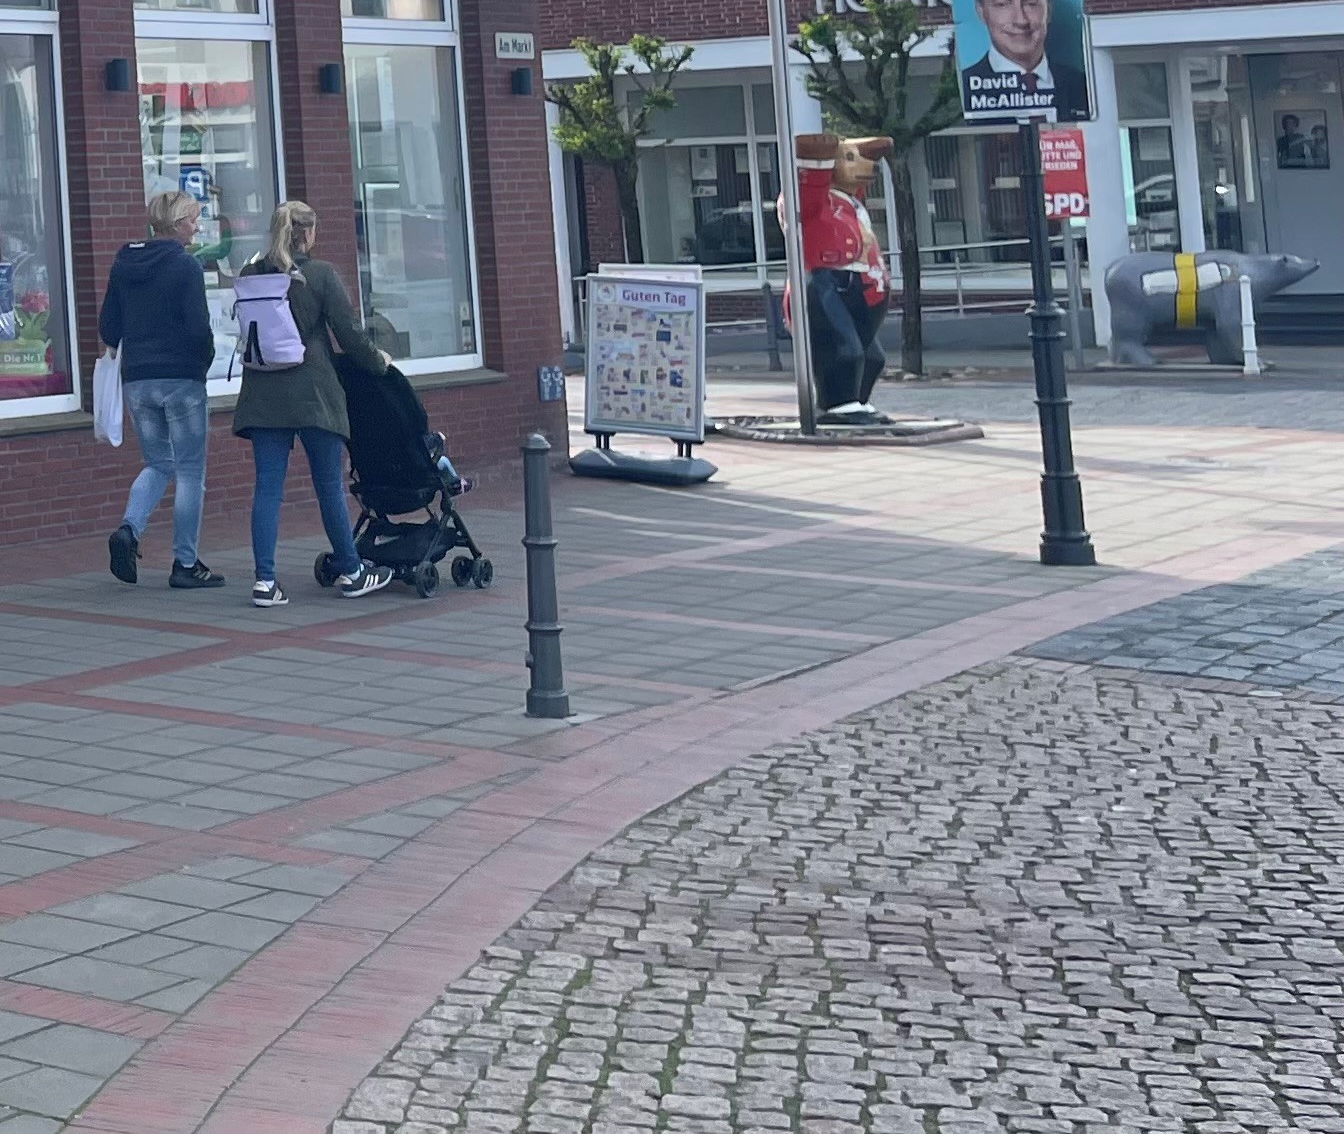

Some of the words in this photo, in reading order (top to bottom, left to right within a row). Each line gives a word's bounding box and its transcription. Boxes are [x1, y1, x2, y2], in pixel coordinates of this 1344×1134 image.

[969, 74, 1018, 91] David
[970, 92, 1054, 110] McAllister
[1044, 192, 1085, 216] SPD
[622, 289, 660, 303] Guten
[664, 291, 686, 307] Tag
